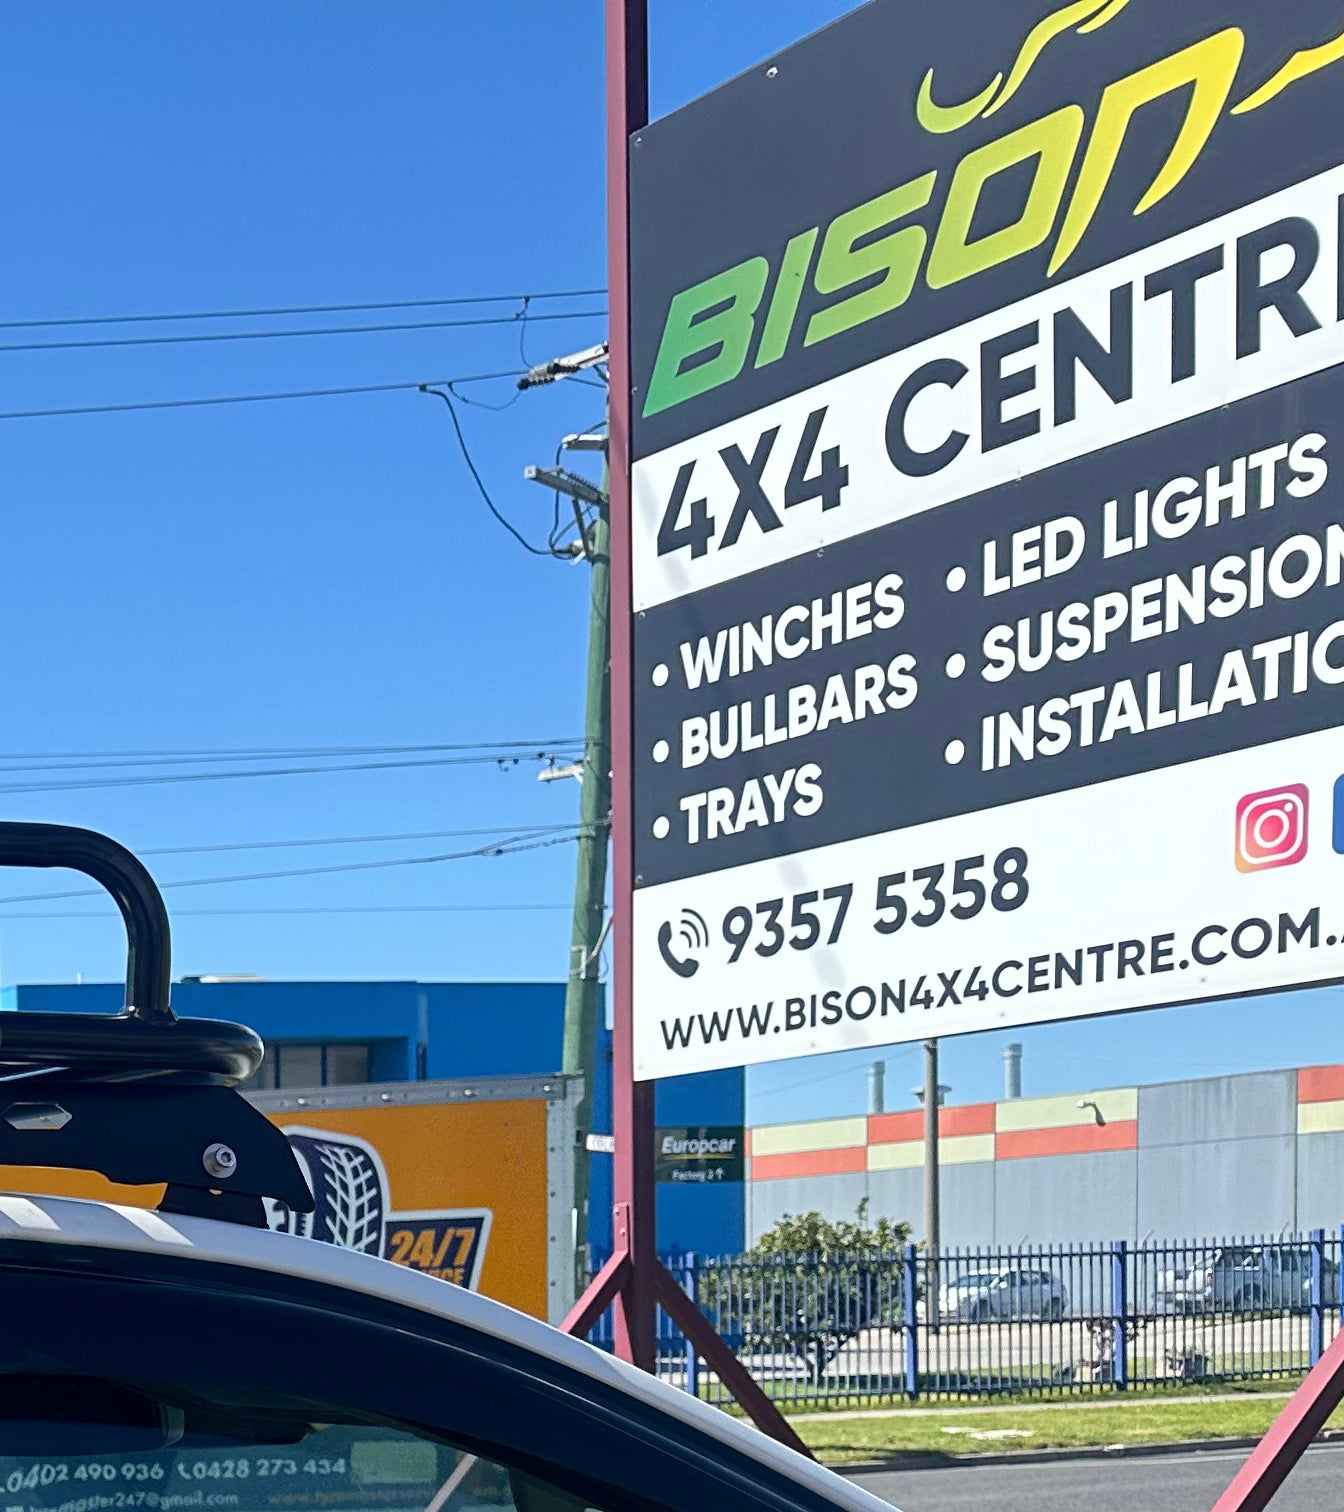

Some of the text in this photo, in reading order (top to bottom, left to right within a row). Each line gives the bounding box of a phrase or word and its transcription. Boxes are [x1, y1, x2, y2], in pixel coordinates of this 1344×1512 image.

[642, 27, 1245, 418] BISON
[655, 192, 1344, 560] 4X4 CENTR
[984, 433, 1328, 596] LED LIGHTS
[680, 573, 905, 690] WINCHES
[681, 653, 918, 769] BULLBARS
[680, 763, 824, 844] TRAYS
[721, 846, 1030, 965] 9357 5358
[660, 905, 1344, 1051] WWW.BISON4X4CENTRE.COM.
[662, 1136, 736, 1157] Europcar
[390, 1228, 476, 1267] 24/7
[6, 1457, 346, 1493] 0402 490 936 0428 273 434
